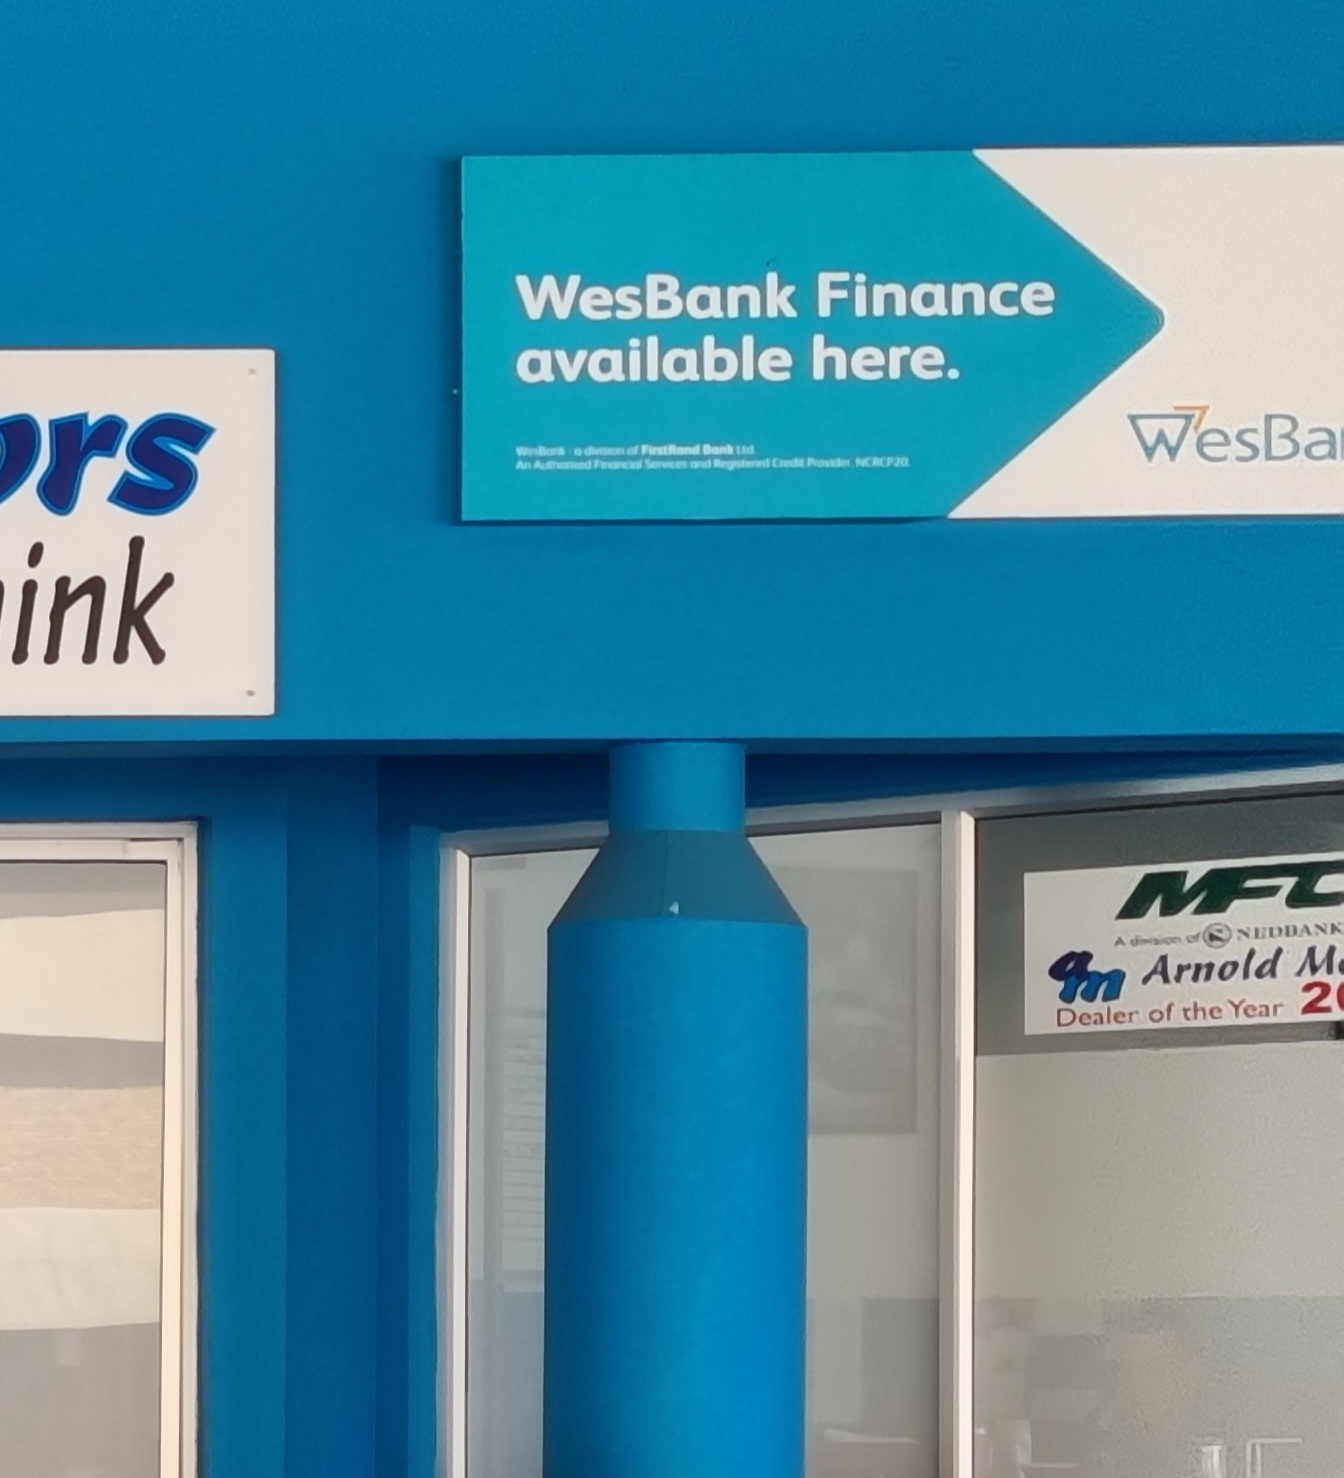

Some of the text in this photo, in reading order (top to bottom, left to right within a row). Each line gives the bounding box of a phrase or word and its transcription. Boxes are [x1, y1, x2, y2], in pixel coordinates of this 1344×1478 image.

[516, 271, 1056, 320] WesBank Finance
[516, 334, 960, 383] available here.
[1127, 405, 1344, 463] WesBa
[1141, 947, 1283, 986] Arnold
[1056, 1006, 1139, 1028] Dealer
[1148, 1003, 1175, 1024] of
[1182, 1001, 1224, 1022] the
[1227, 999, 1285, 1019] Year
